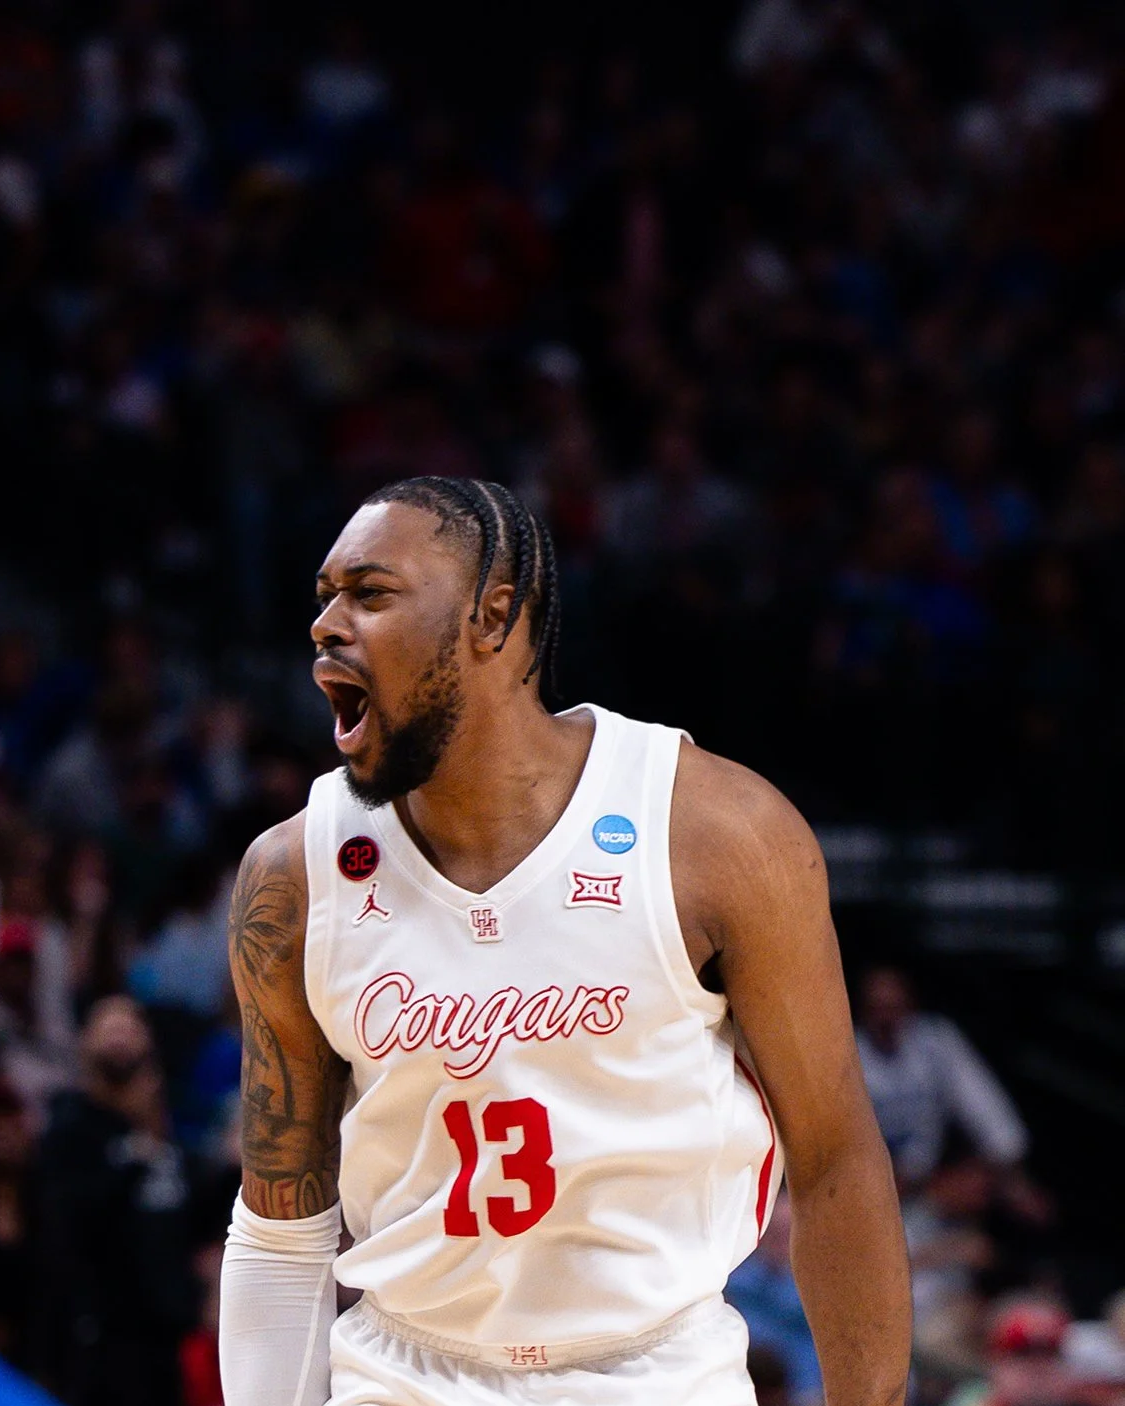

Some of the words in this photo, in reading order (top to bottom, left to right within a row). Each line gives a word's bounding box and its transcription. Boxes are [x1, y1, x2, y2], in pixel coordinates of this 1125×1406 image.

[346, 845, 373, 872] 32
[598, 831, 635, 844] NCAA
[354, 971, 630, 1080] Cougars
[442, 1097, 556, 1237] 13
